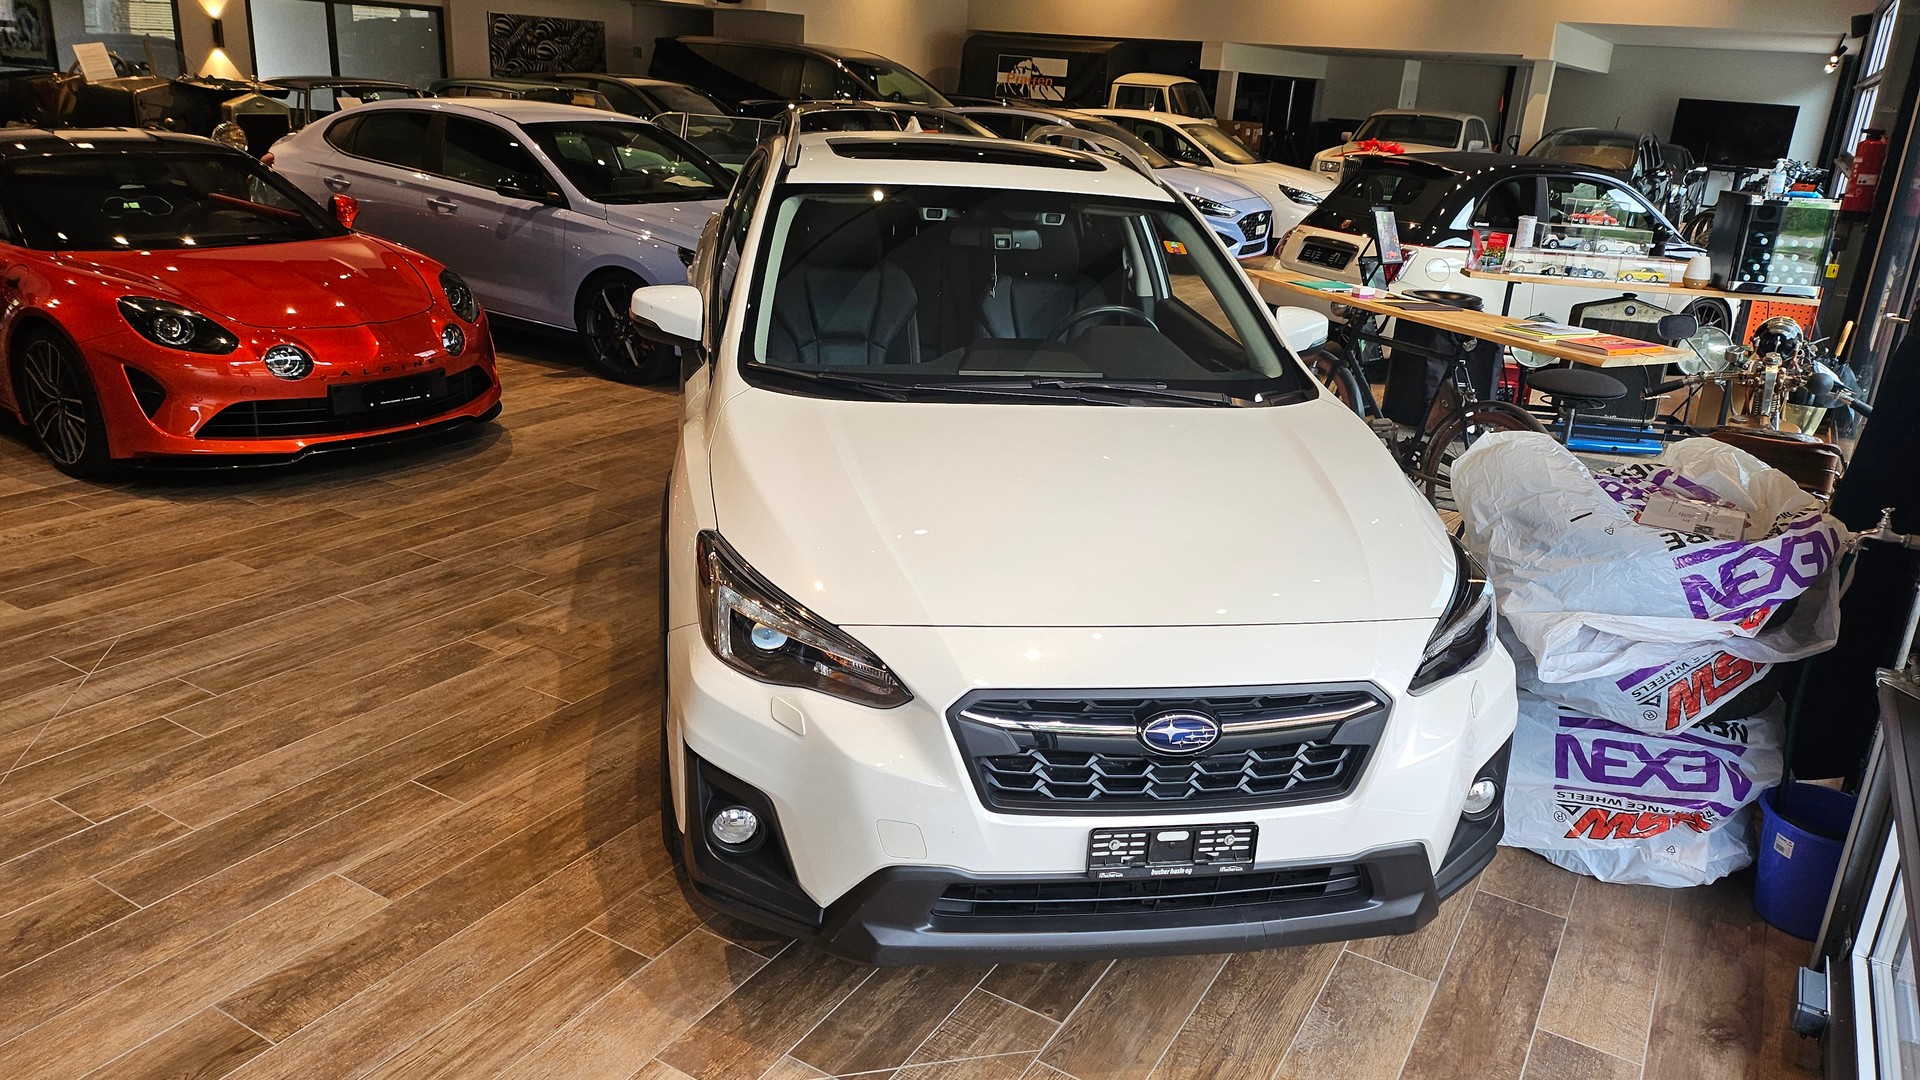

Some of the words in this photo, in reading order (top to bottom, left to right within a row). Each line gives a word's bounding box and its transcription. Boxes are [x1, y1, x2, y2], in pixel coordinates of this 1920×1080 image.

[341, 359, 435, 376] ALPINE
[1679, 528, 1840, 621] NEXEN
[1631, 661, 1690, 699] WHEELS
[1664, 650, 1764, 731] SW
[1555, 733, 1752, 803] NEXEN
[1556, 790, 1623, 808] WHEELS
